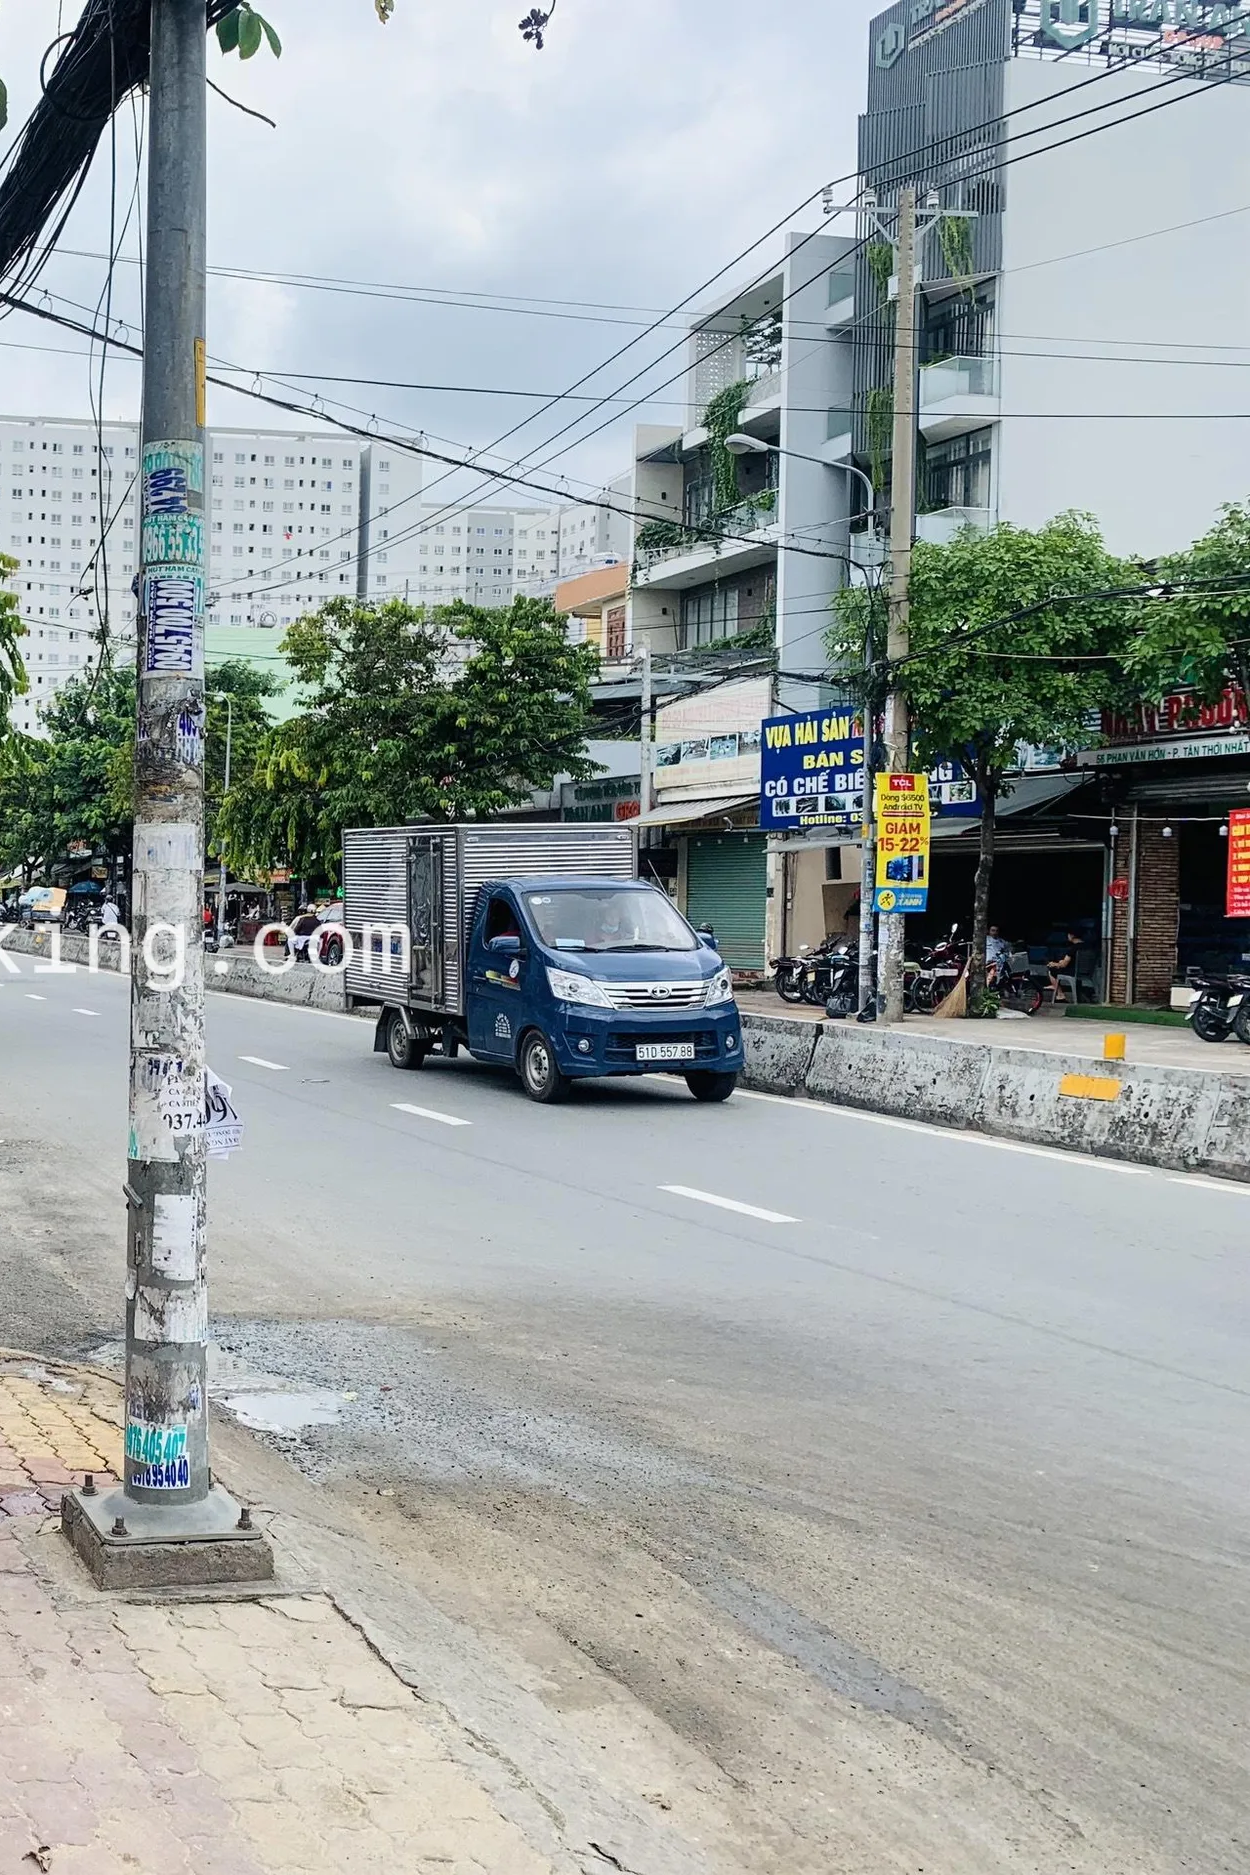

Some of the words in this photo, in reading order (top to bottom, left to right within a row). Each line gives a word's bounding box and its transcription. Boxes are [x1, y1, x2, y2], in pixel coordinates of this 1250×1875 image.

[795, 714, 818, 745] HẢI
[822, 711, 850, 742] SẢN
[803, 750, 844, 770] BÁN
[850, 749, 864, 765] S
[1106, 752, 1128, 764] PHAN
[1183, 745, 1200, 757] TÂN
[765, 774, 788, 797] CÓ
[793, 769, 829, 795] CHẾ
[892, 779, 912, 787] TCL
[800, 814, 847, 826] Hotline:
